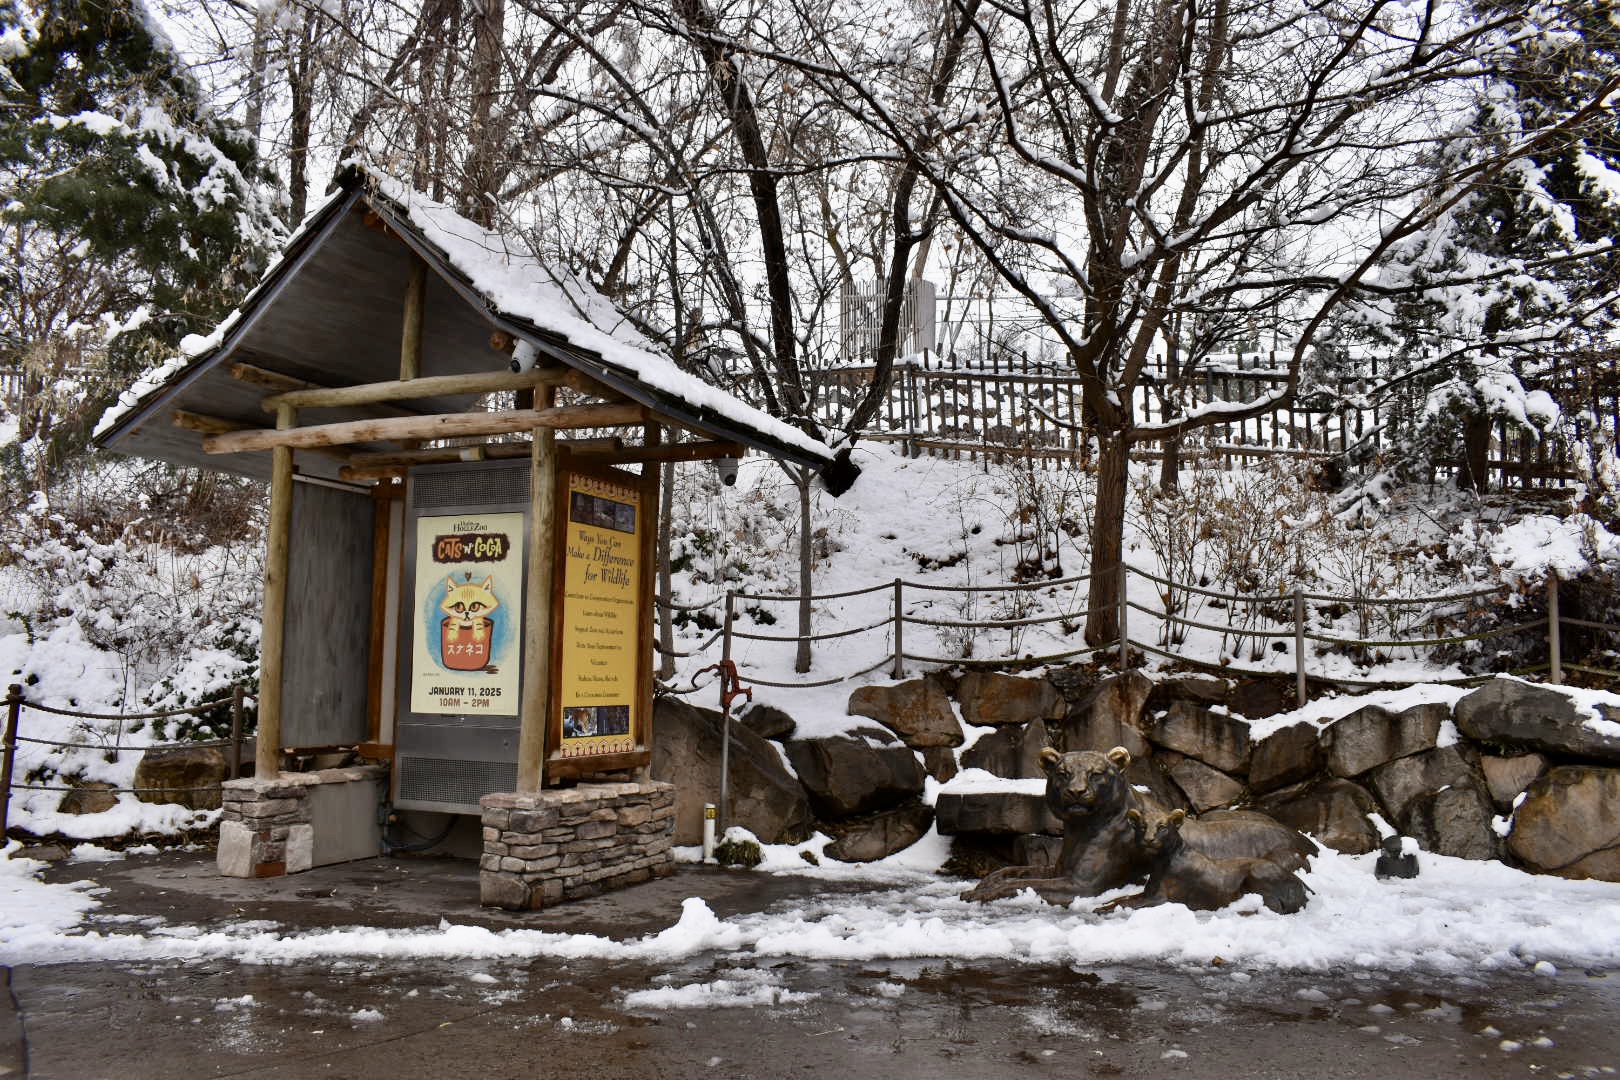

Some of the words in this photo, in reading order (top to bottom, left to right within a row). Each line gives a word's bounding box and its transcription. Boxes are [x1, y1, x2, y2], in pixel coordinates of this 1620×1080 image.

[438, 538, 462, 560] CATS
[474, 536, 502, 558] COCOA
[579, 530, 594, 545] Ways
[597, 533, 608, 546] You
[609, 536, 621, 548] Can
[566, 545, 585, 559] Make
[593, 546, 635, 567] Difference
[584, 563, 598, 585] for
[601, 567, 630, 590] Wildlife
[447, 643, 484, 657] スナネコ
[428, 686, 465, 697] JANUARY
[467, 687, 477, 698] 11,
[479, 687, 502, 697] 2025
[439, 698, 461, 707] 10AM
[471, 698, 490, 708] 2PM
